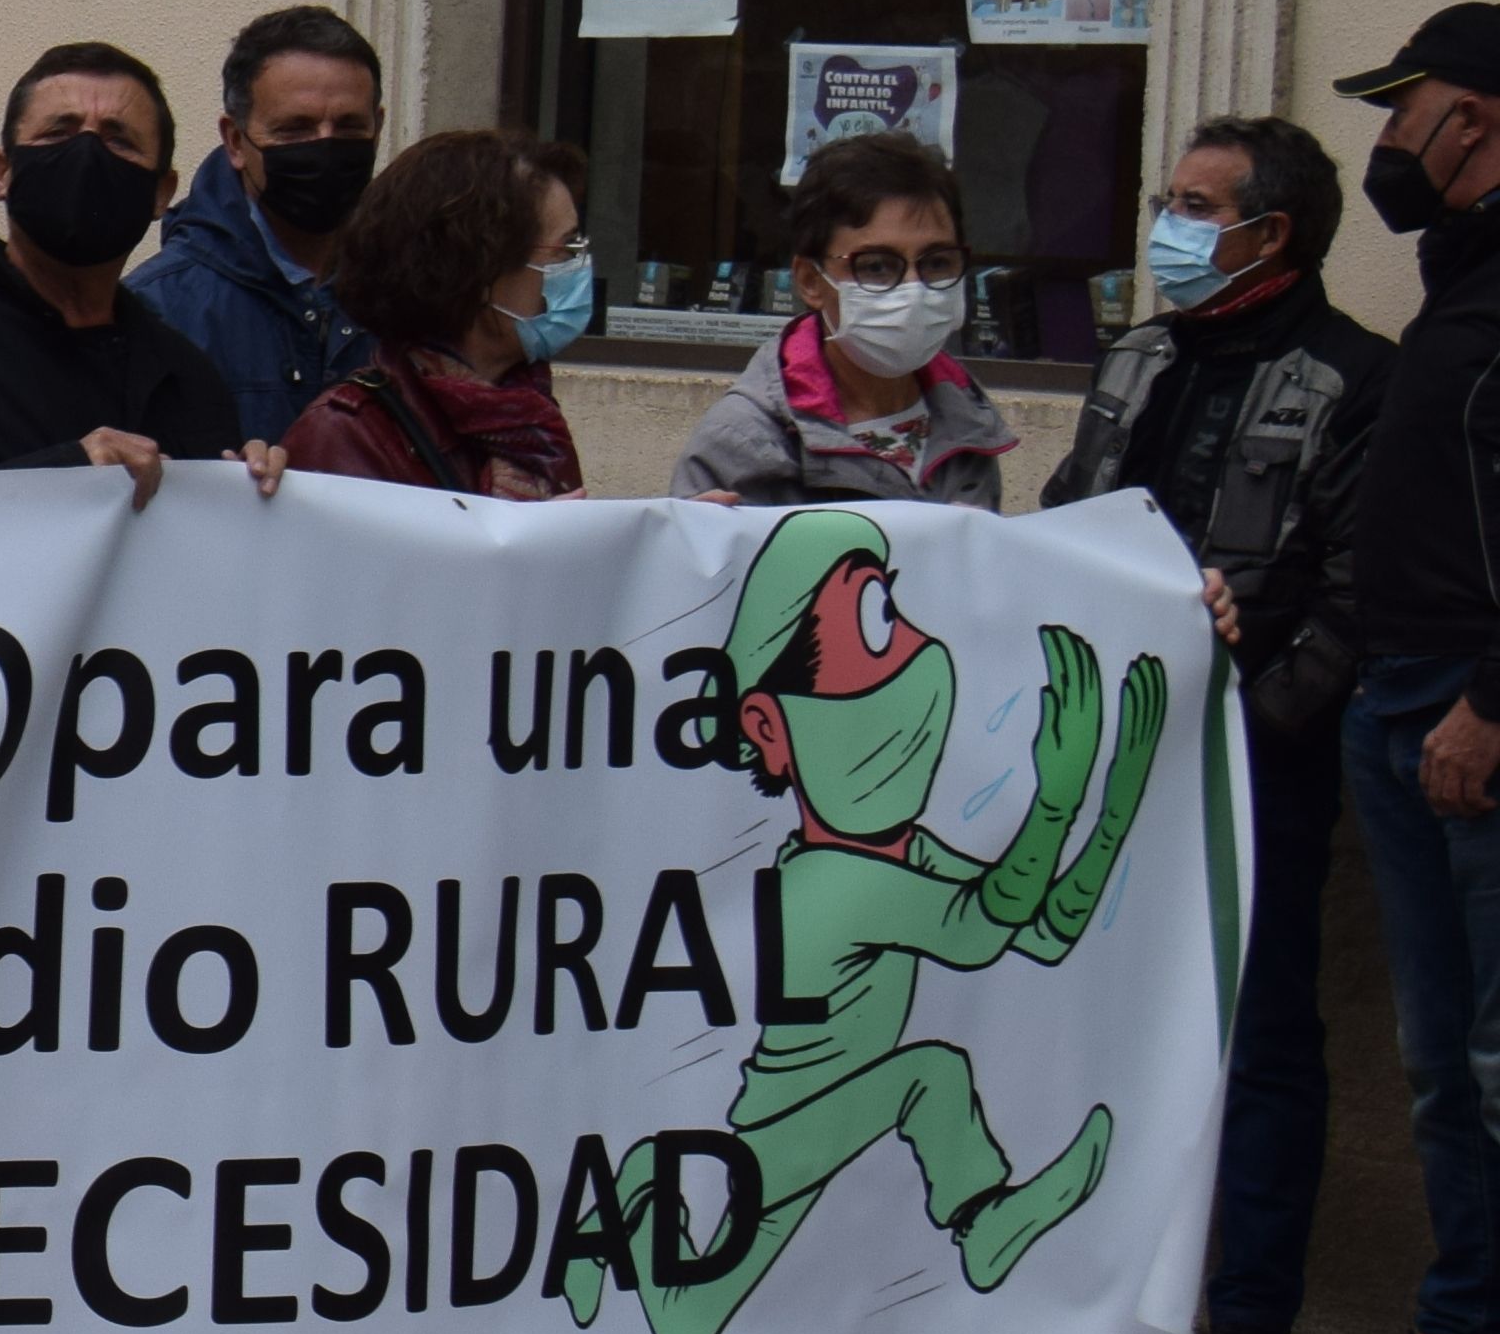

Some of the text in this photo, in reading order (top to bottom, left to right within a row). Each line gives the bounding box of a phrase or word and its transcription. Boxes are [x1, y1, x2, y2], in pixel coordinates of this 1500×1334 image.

[824, 70, 900, 86] CONTRA EL
[829, 85, 892, 99] TRABAJO
[826, 98, 896, 115] INFANTIL,
[44, 627, 431, 822] para
[489, 629, 740, 773] una
[322, 865, 831, 1052] RURAL
